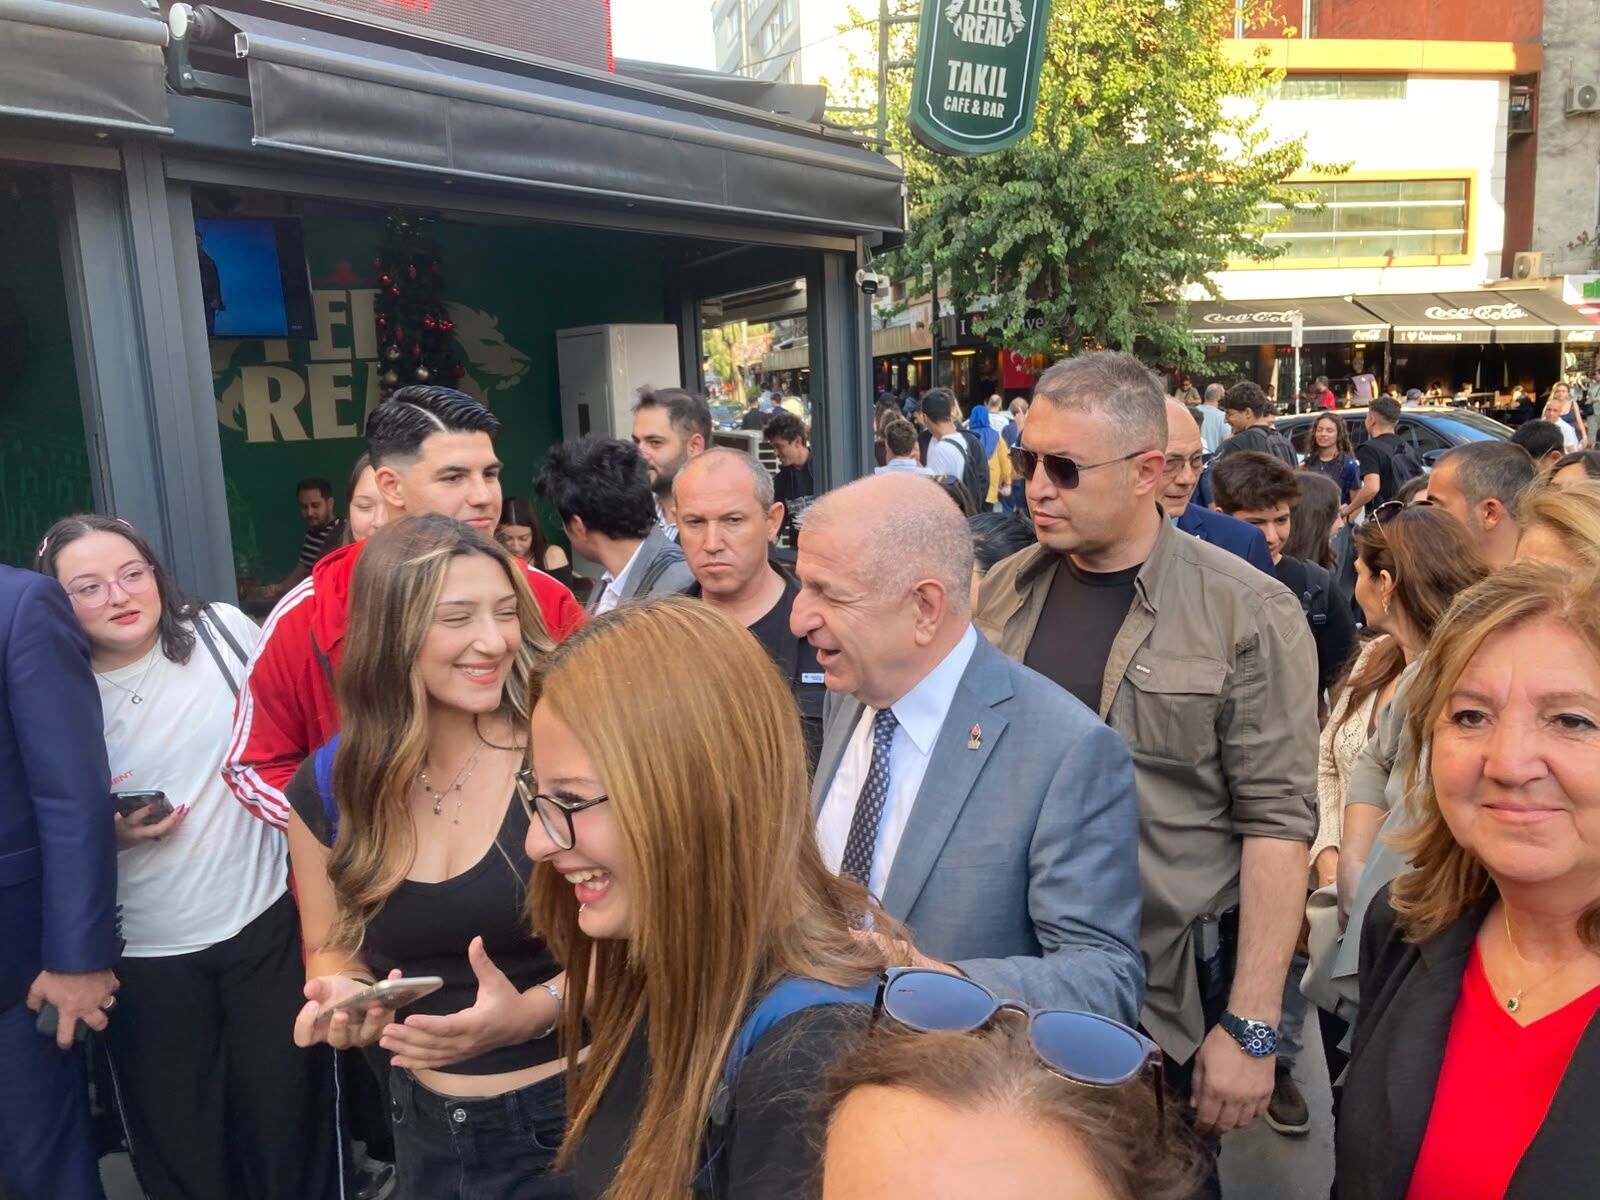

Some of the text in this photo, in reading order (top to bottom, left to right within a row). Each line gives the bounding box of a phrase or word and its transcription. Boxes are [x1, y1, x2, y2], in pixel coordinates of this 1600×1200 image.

[962, 13, 1006, 47] REAL
[948, 60, 1007, 98] TAKIL
[943, 96, 1004, 118] CAFE & BAR
